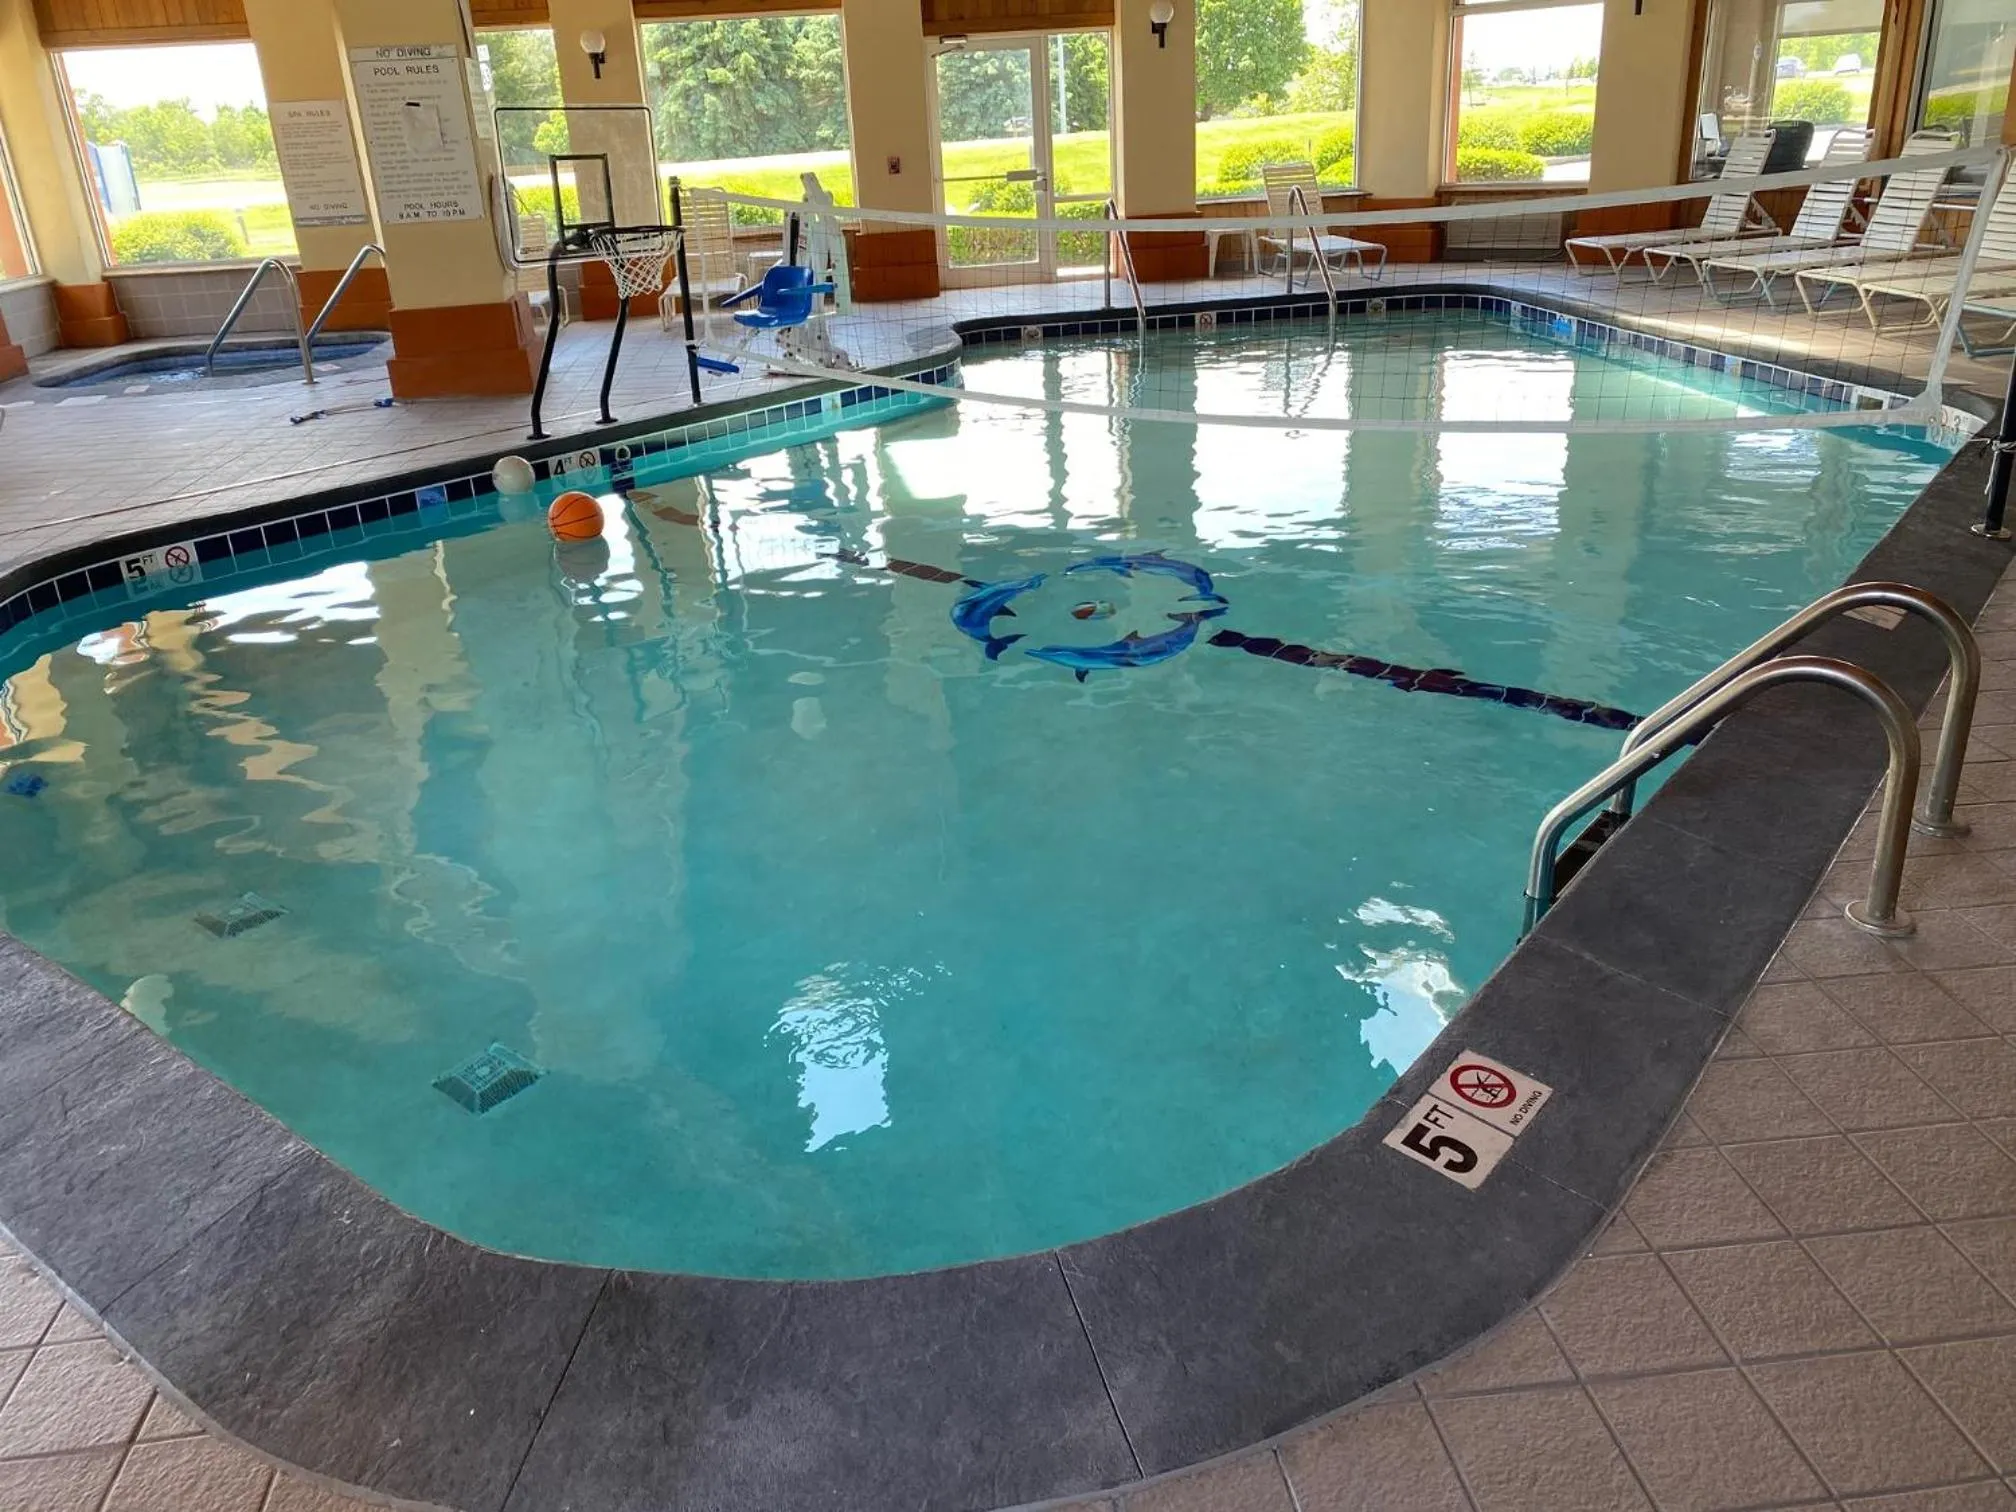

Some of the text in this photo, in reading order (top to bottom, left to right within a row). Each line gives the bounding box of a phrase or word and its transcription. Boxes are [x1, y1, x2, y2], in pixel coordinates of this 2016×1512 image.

[376, 47, 431, 58] NO DIVING
[373, 64, 440, 76] POOL RULES
[404, 201, 459, 211] POOL HOURS
[553, 456, 572, 475] 4 FT
[124, 554, 154, 580] 5 FT
[1509, 1089, 1543, 1126] NO DIVING
[1400, 1103, 1478, 1174] 5 FT
